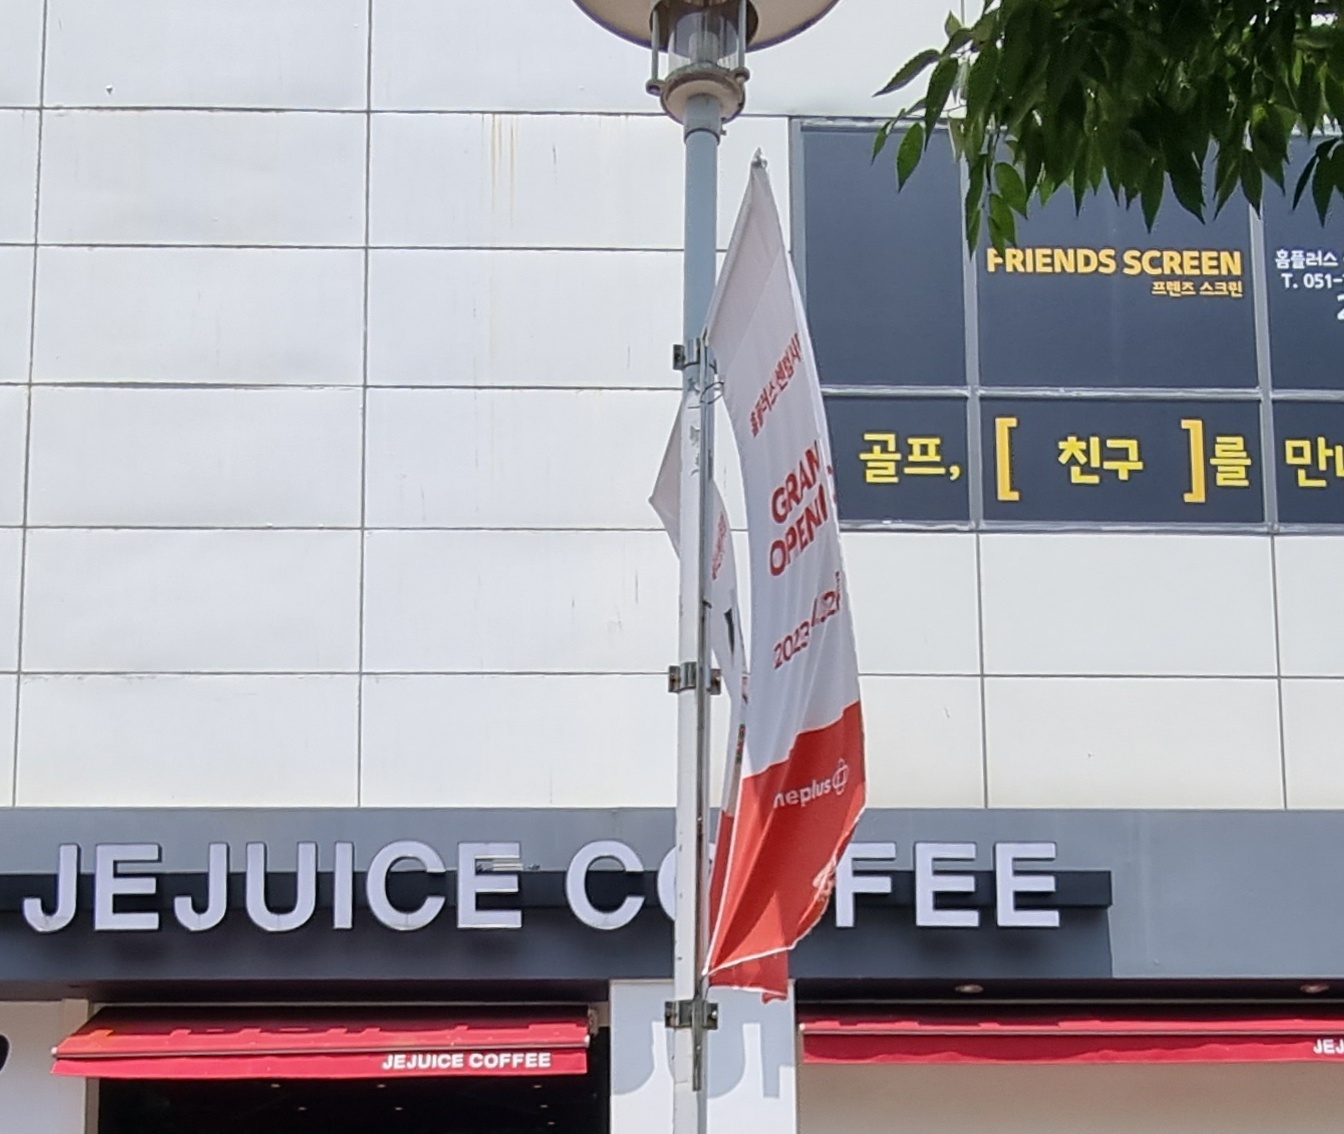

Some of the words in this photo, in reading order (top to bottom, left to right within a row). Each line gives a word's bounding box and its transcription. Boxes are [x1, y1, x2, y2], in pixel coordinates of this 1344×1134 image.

[987, 247, 1118, 275] FRIENDS
[1123, 249, 1243, 277] SCREEN
[1275, 249, 1339, 271] 홈플러스
[1151, 280, 1196, 297] 프렌즈
[1199, 280, 1244, 298] 스크린
[1281, 274, 1298, 290] T.
[859, 432, 961, 485] 골프,
[1058, 436, 1145, 486] 친구
[771, 440, 820, 524] GRAN
[770, 483, 828, 576] OPENI
[22, 839, 524, 932] JEJUICE
[565, 839, 1060, 932] CFEE
[382, 1053, 464, 1070] JEJUICE
[468, 1052, 551, 1069] COFFEE
